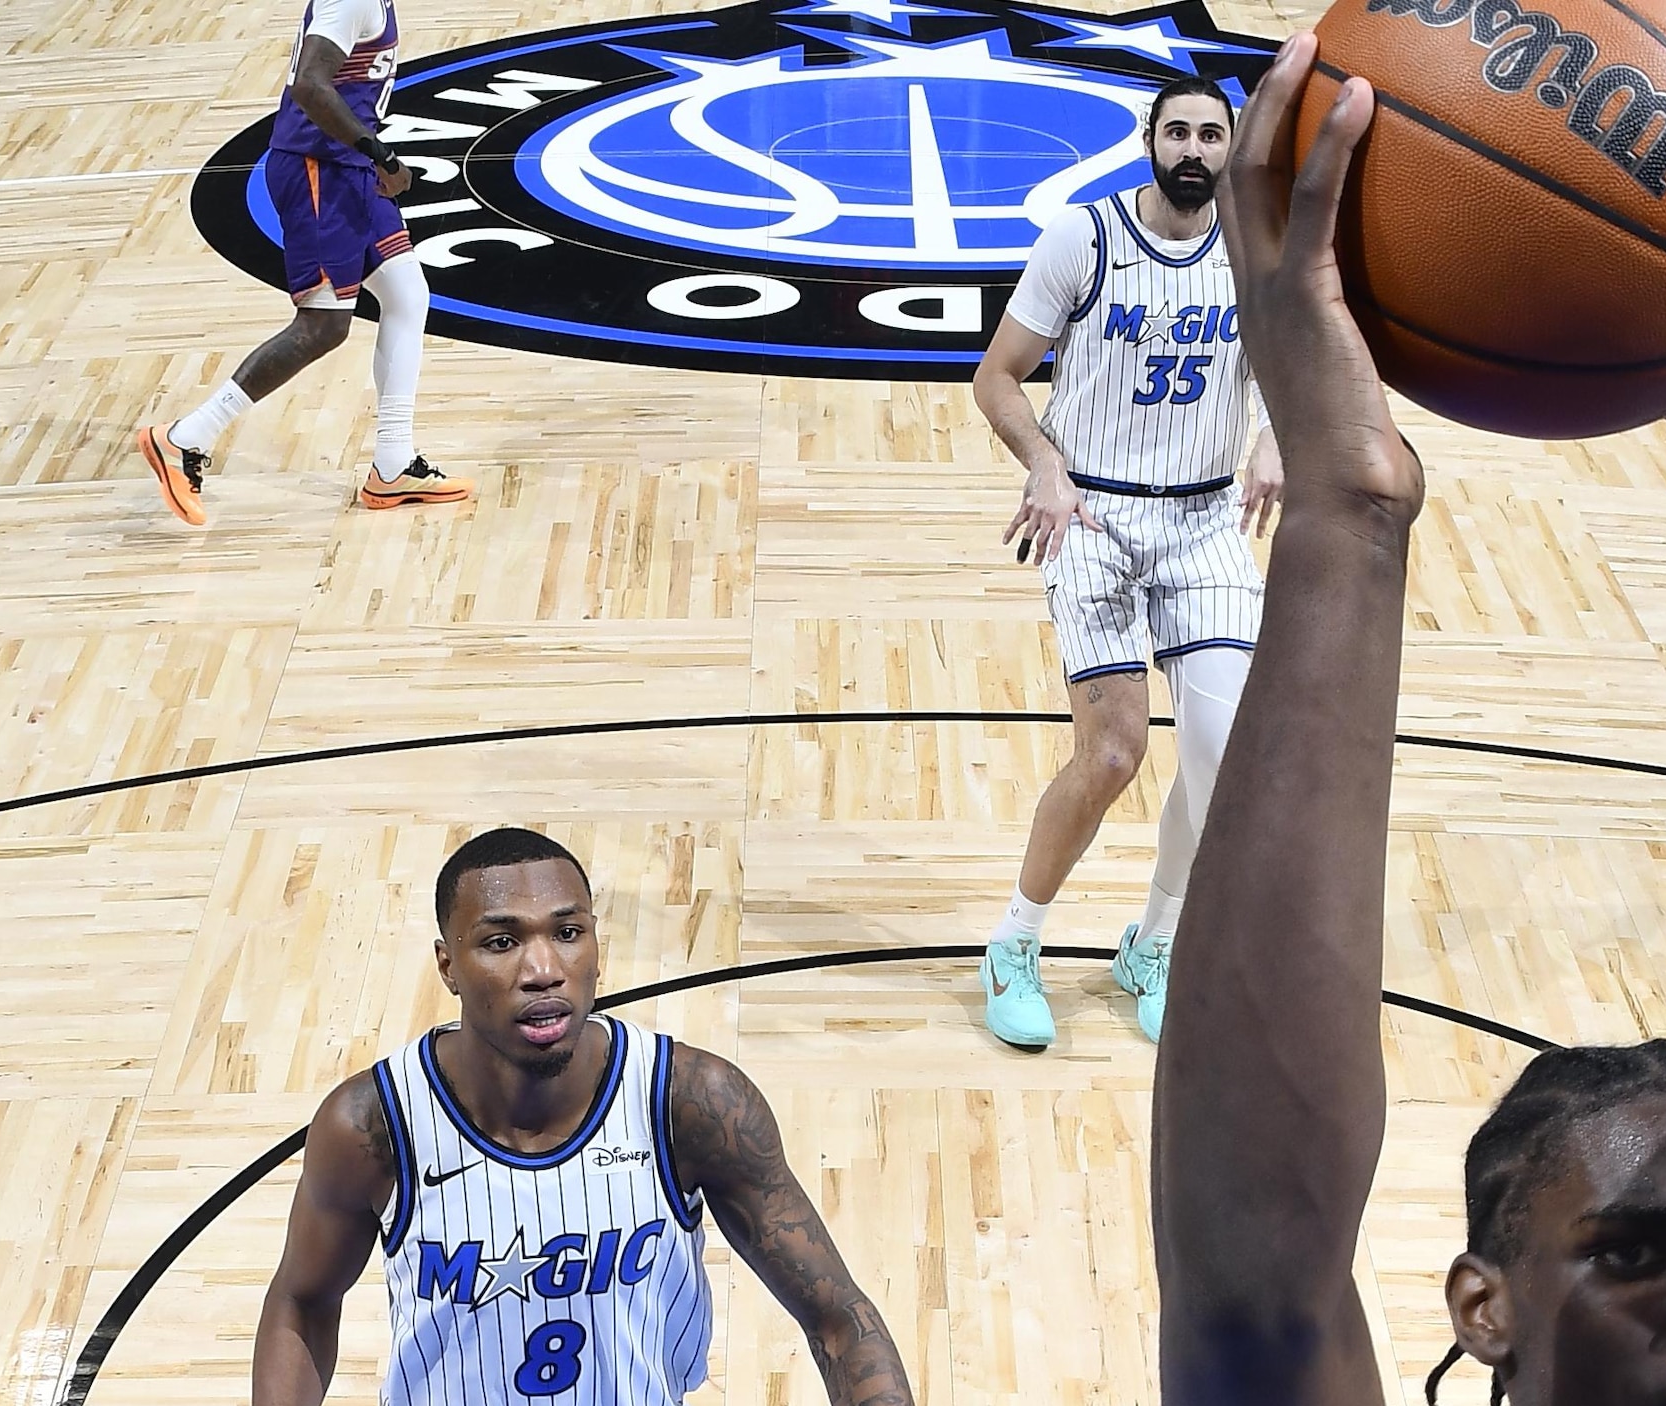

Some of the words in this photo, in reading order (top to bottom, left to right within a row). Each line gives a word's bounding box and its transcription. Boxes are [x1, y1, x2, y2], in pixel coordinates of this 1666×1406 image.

[1133, 355, 1212, 405] 35
[588, 1146, 651, 1167] Disney
[514, 1319, 587, 1397] 8
